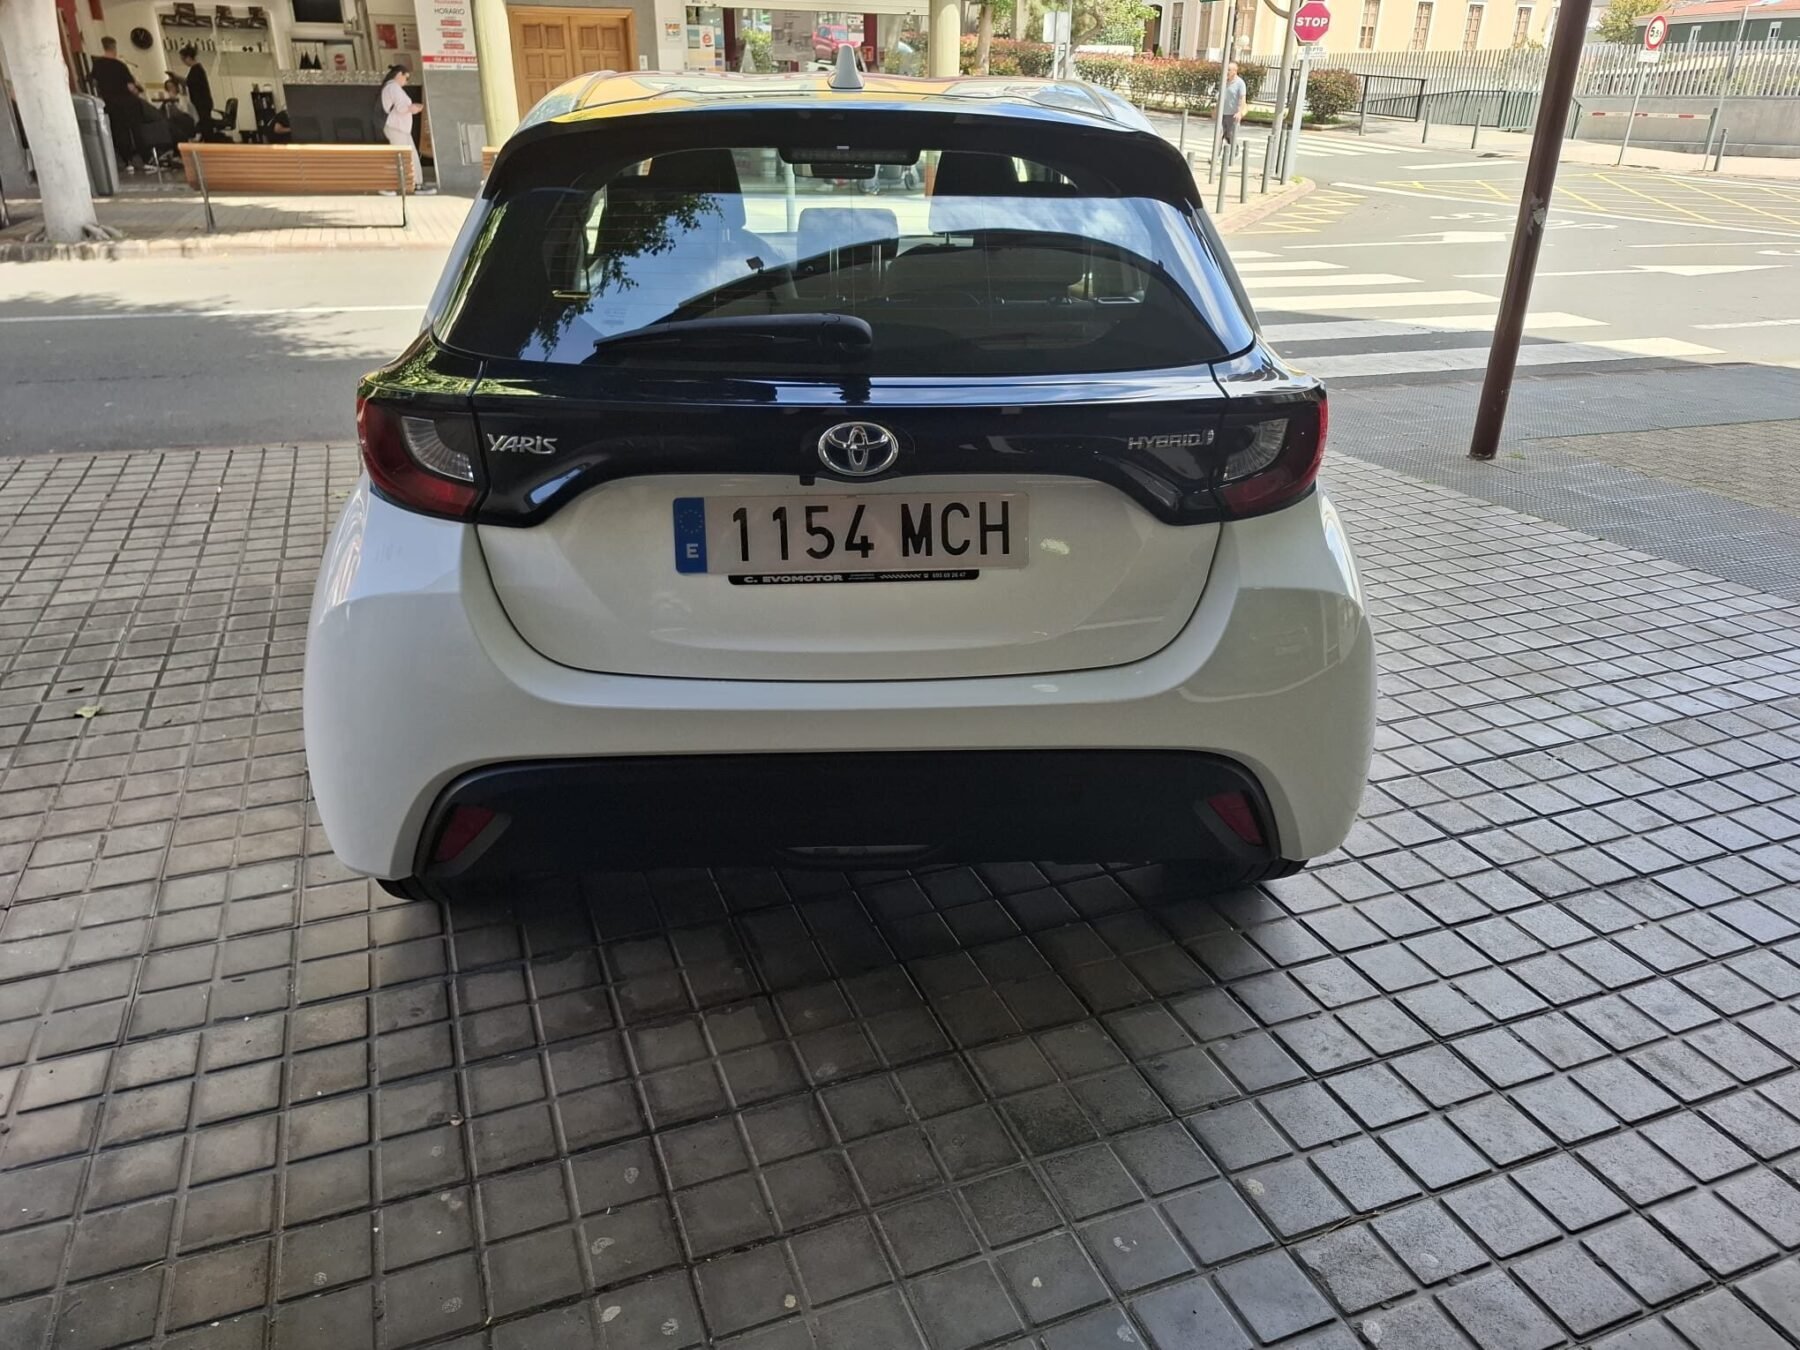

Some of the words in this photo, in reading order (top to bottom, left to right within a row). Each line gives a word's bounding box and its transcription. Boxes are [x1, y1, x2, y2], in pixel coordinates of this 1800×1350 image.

[1295, 16, 1329, 28] STOP
[1128, 433, 1203, 450] HYBRID
[732, 504, 875, 562] 1154
[901, 500, 1010, 557] MCH
[686, 543, 700, 558] E
[743, 576, 758, 584] C.
[762, 574, 843, 583] EVOMOTOR
